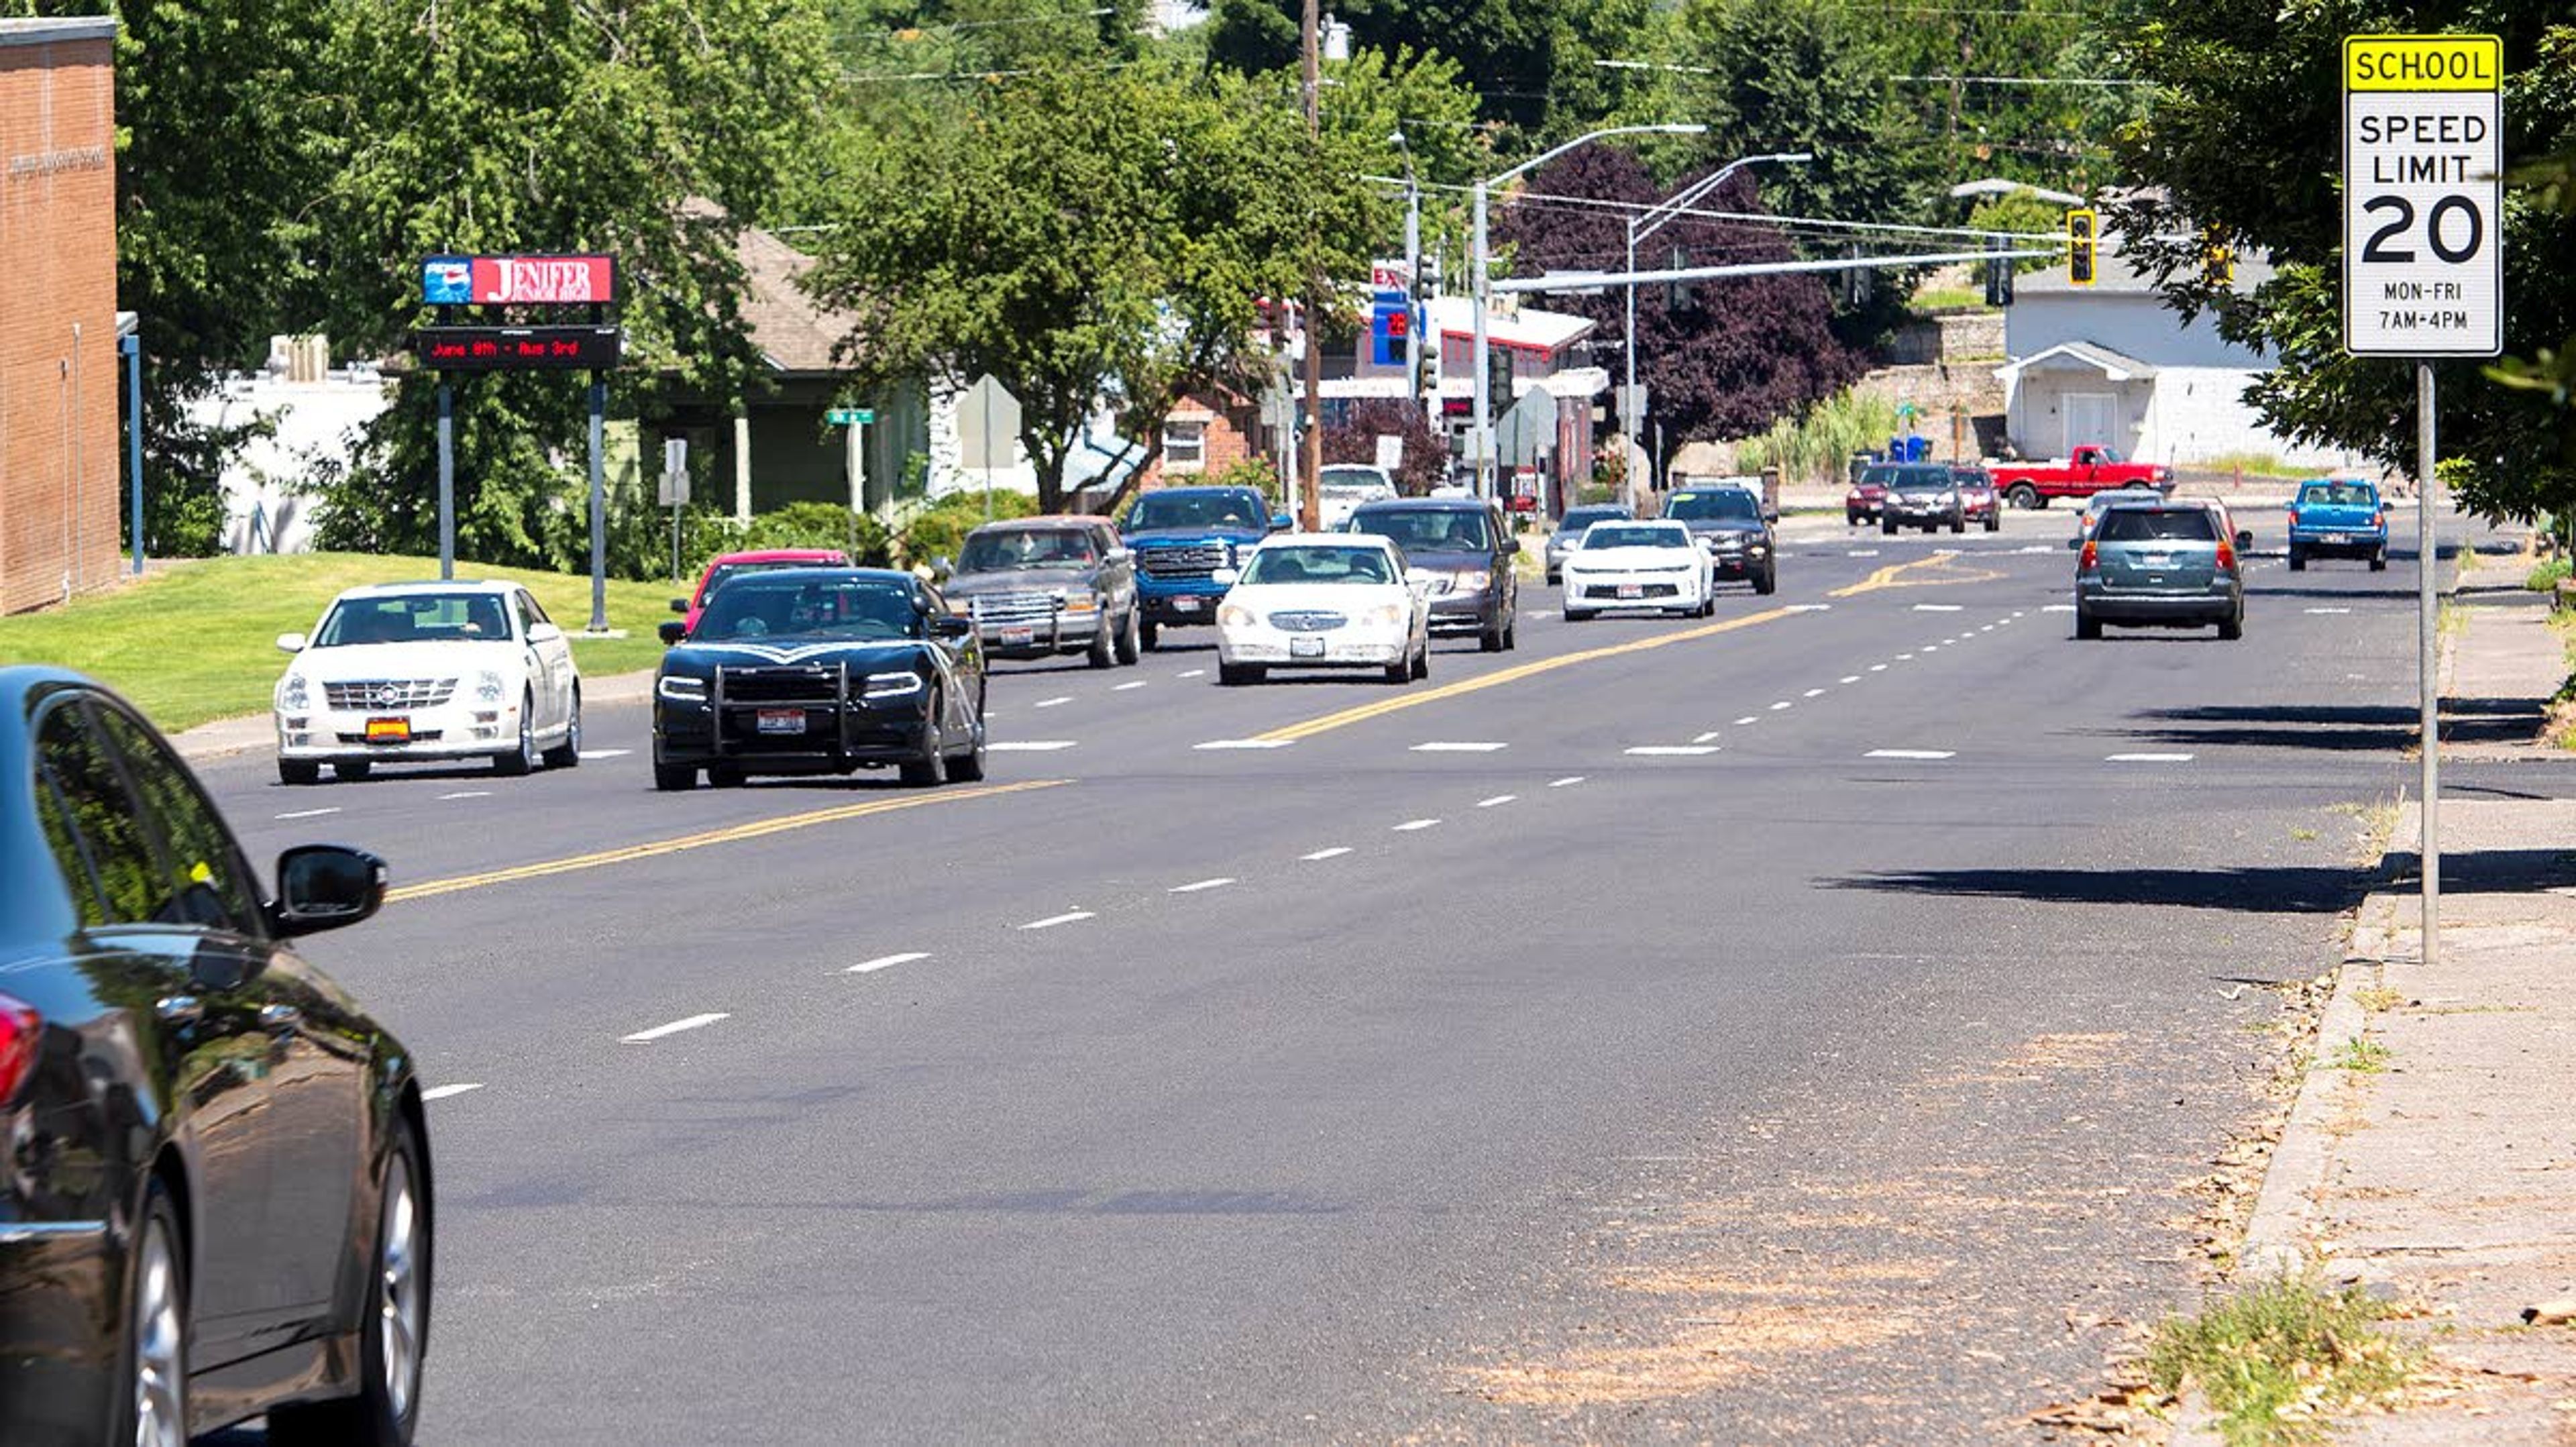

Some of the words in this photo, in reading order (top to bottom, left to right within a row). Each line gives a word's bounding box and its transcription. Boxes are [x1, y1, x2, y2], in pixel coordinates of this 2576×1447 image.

[2357, 52, 2491, 80] SCHOOL
[2359, 115, 2486, 143] SPEED
[2373, 156, 2471, 183] LIMIT
[2361, 195, 2483, 264] 20
[488, 260, 590, 301] JENIFER
[2384, 282, 2461, 301] MON-FRI
[2379, 311, 2468, 329] 7AM-4PM
